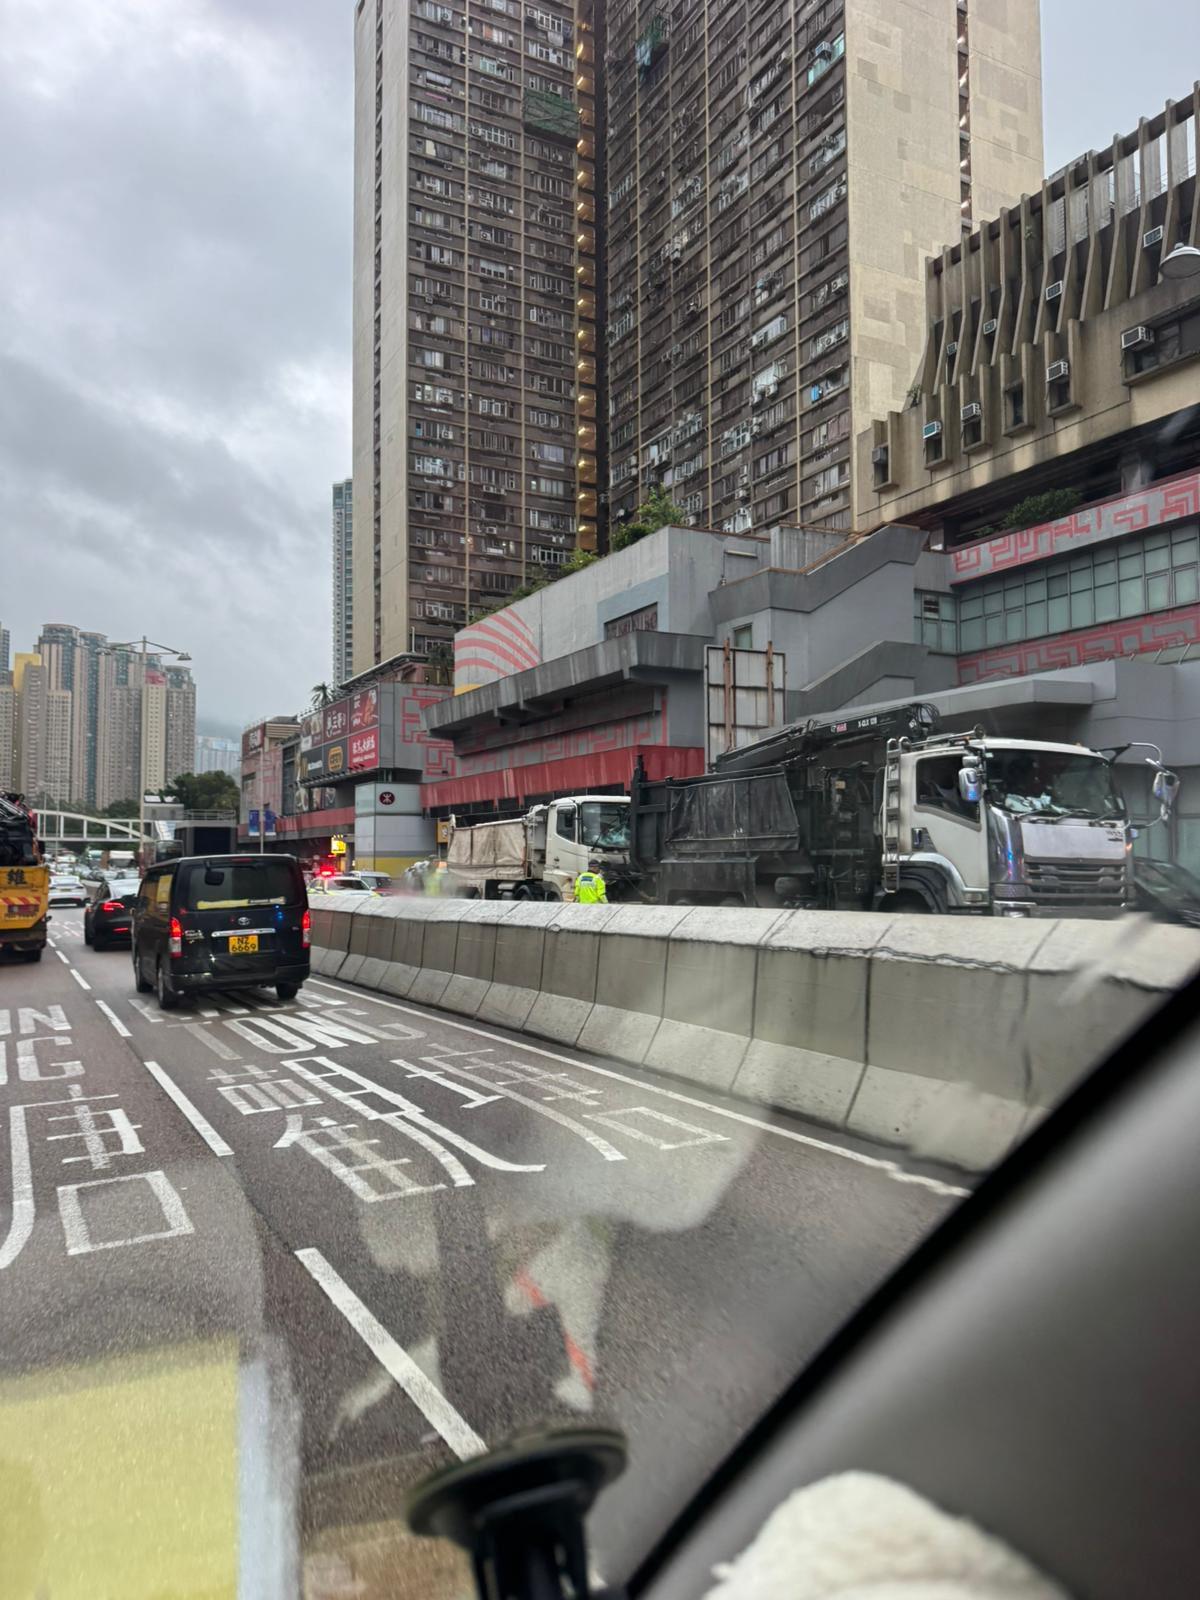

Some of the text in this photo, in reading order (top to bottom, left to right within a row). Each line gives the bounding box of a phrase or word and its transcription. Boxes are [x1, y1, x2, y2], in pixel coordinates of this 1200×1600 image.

[231, 944, 257, 952] 6669
[237, 936, 250, 945] NZ
[167, 1008, 427, 1060] TONG
[207, 1043, 730, 1202] 觀塘
